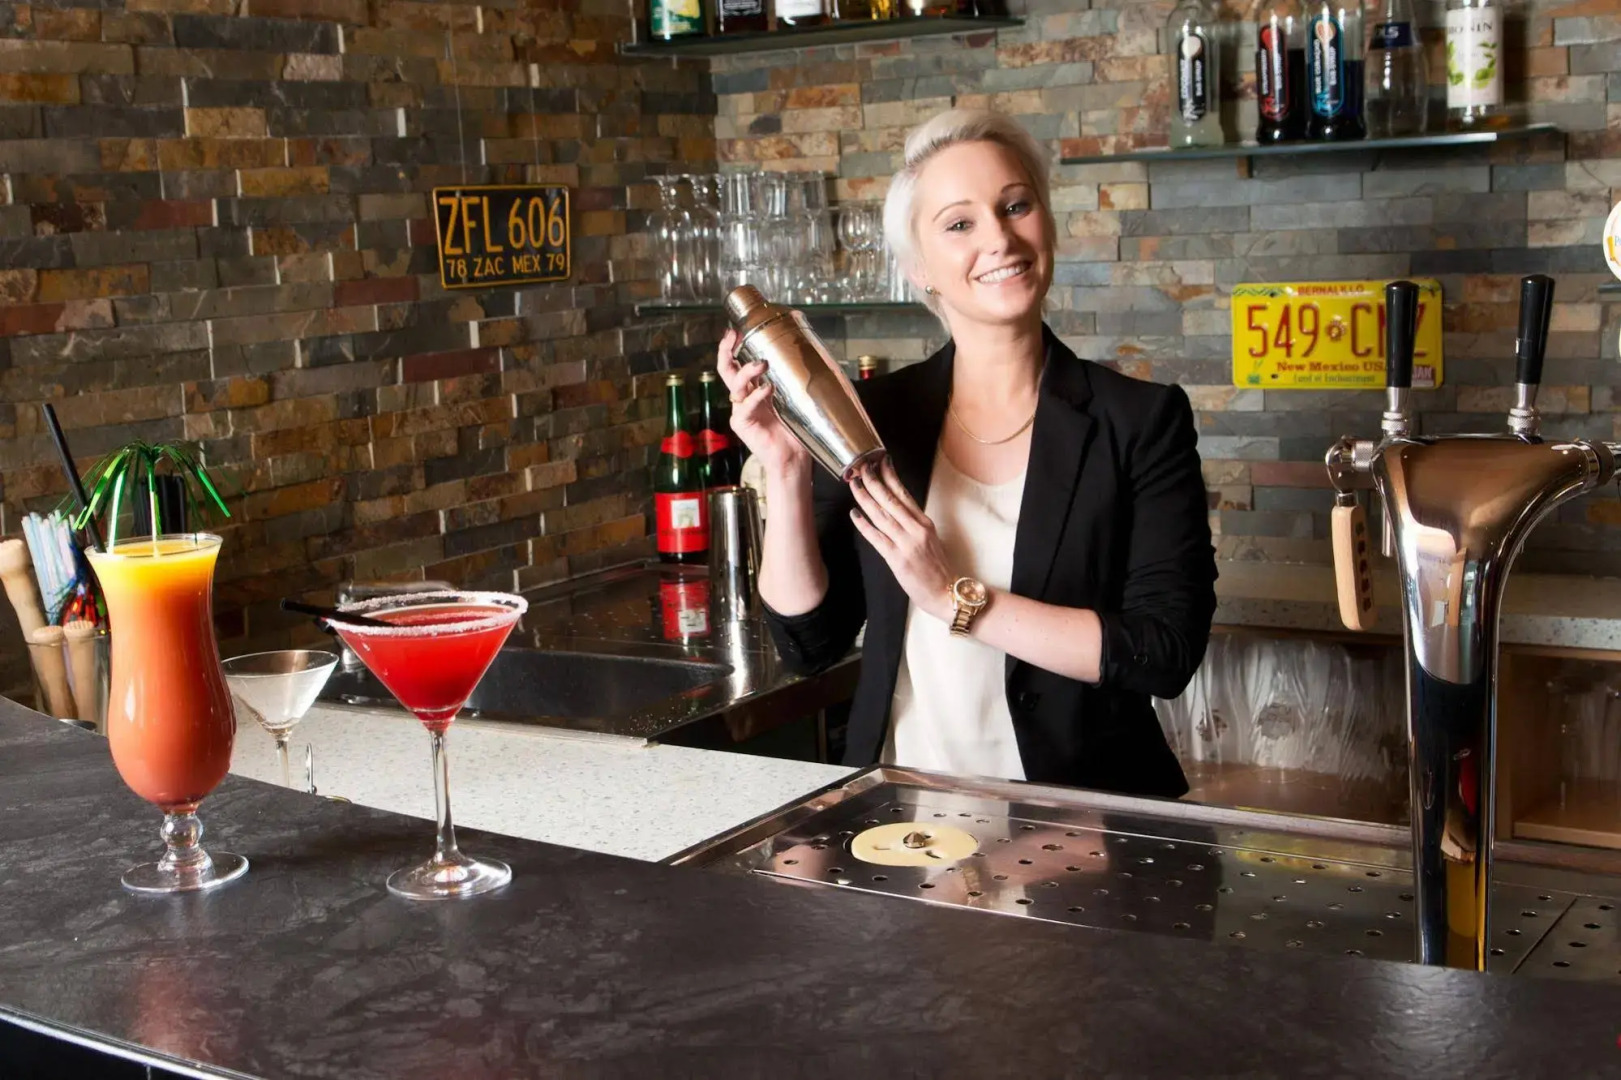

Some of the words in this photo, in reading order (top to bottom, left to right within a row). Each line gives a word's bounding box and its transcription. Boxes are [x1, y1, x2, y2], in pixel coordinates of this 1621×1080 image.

[439, 196, 504, 255] ZFL
[508, 196, 565, 249] 606
[446, 258, 467, 279] 78
[473, 257, 505, 277] ZAC
[512, 254, 541, 274] MEX
[546, 253, 565, 271] 79
[1247, 302, 1320, 359] 549
[1276, 361, 1306, 372] New
[1309, 361, 1360, 372] Mexico
